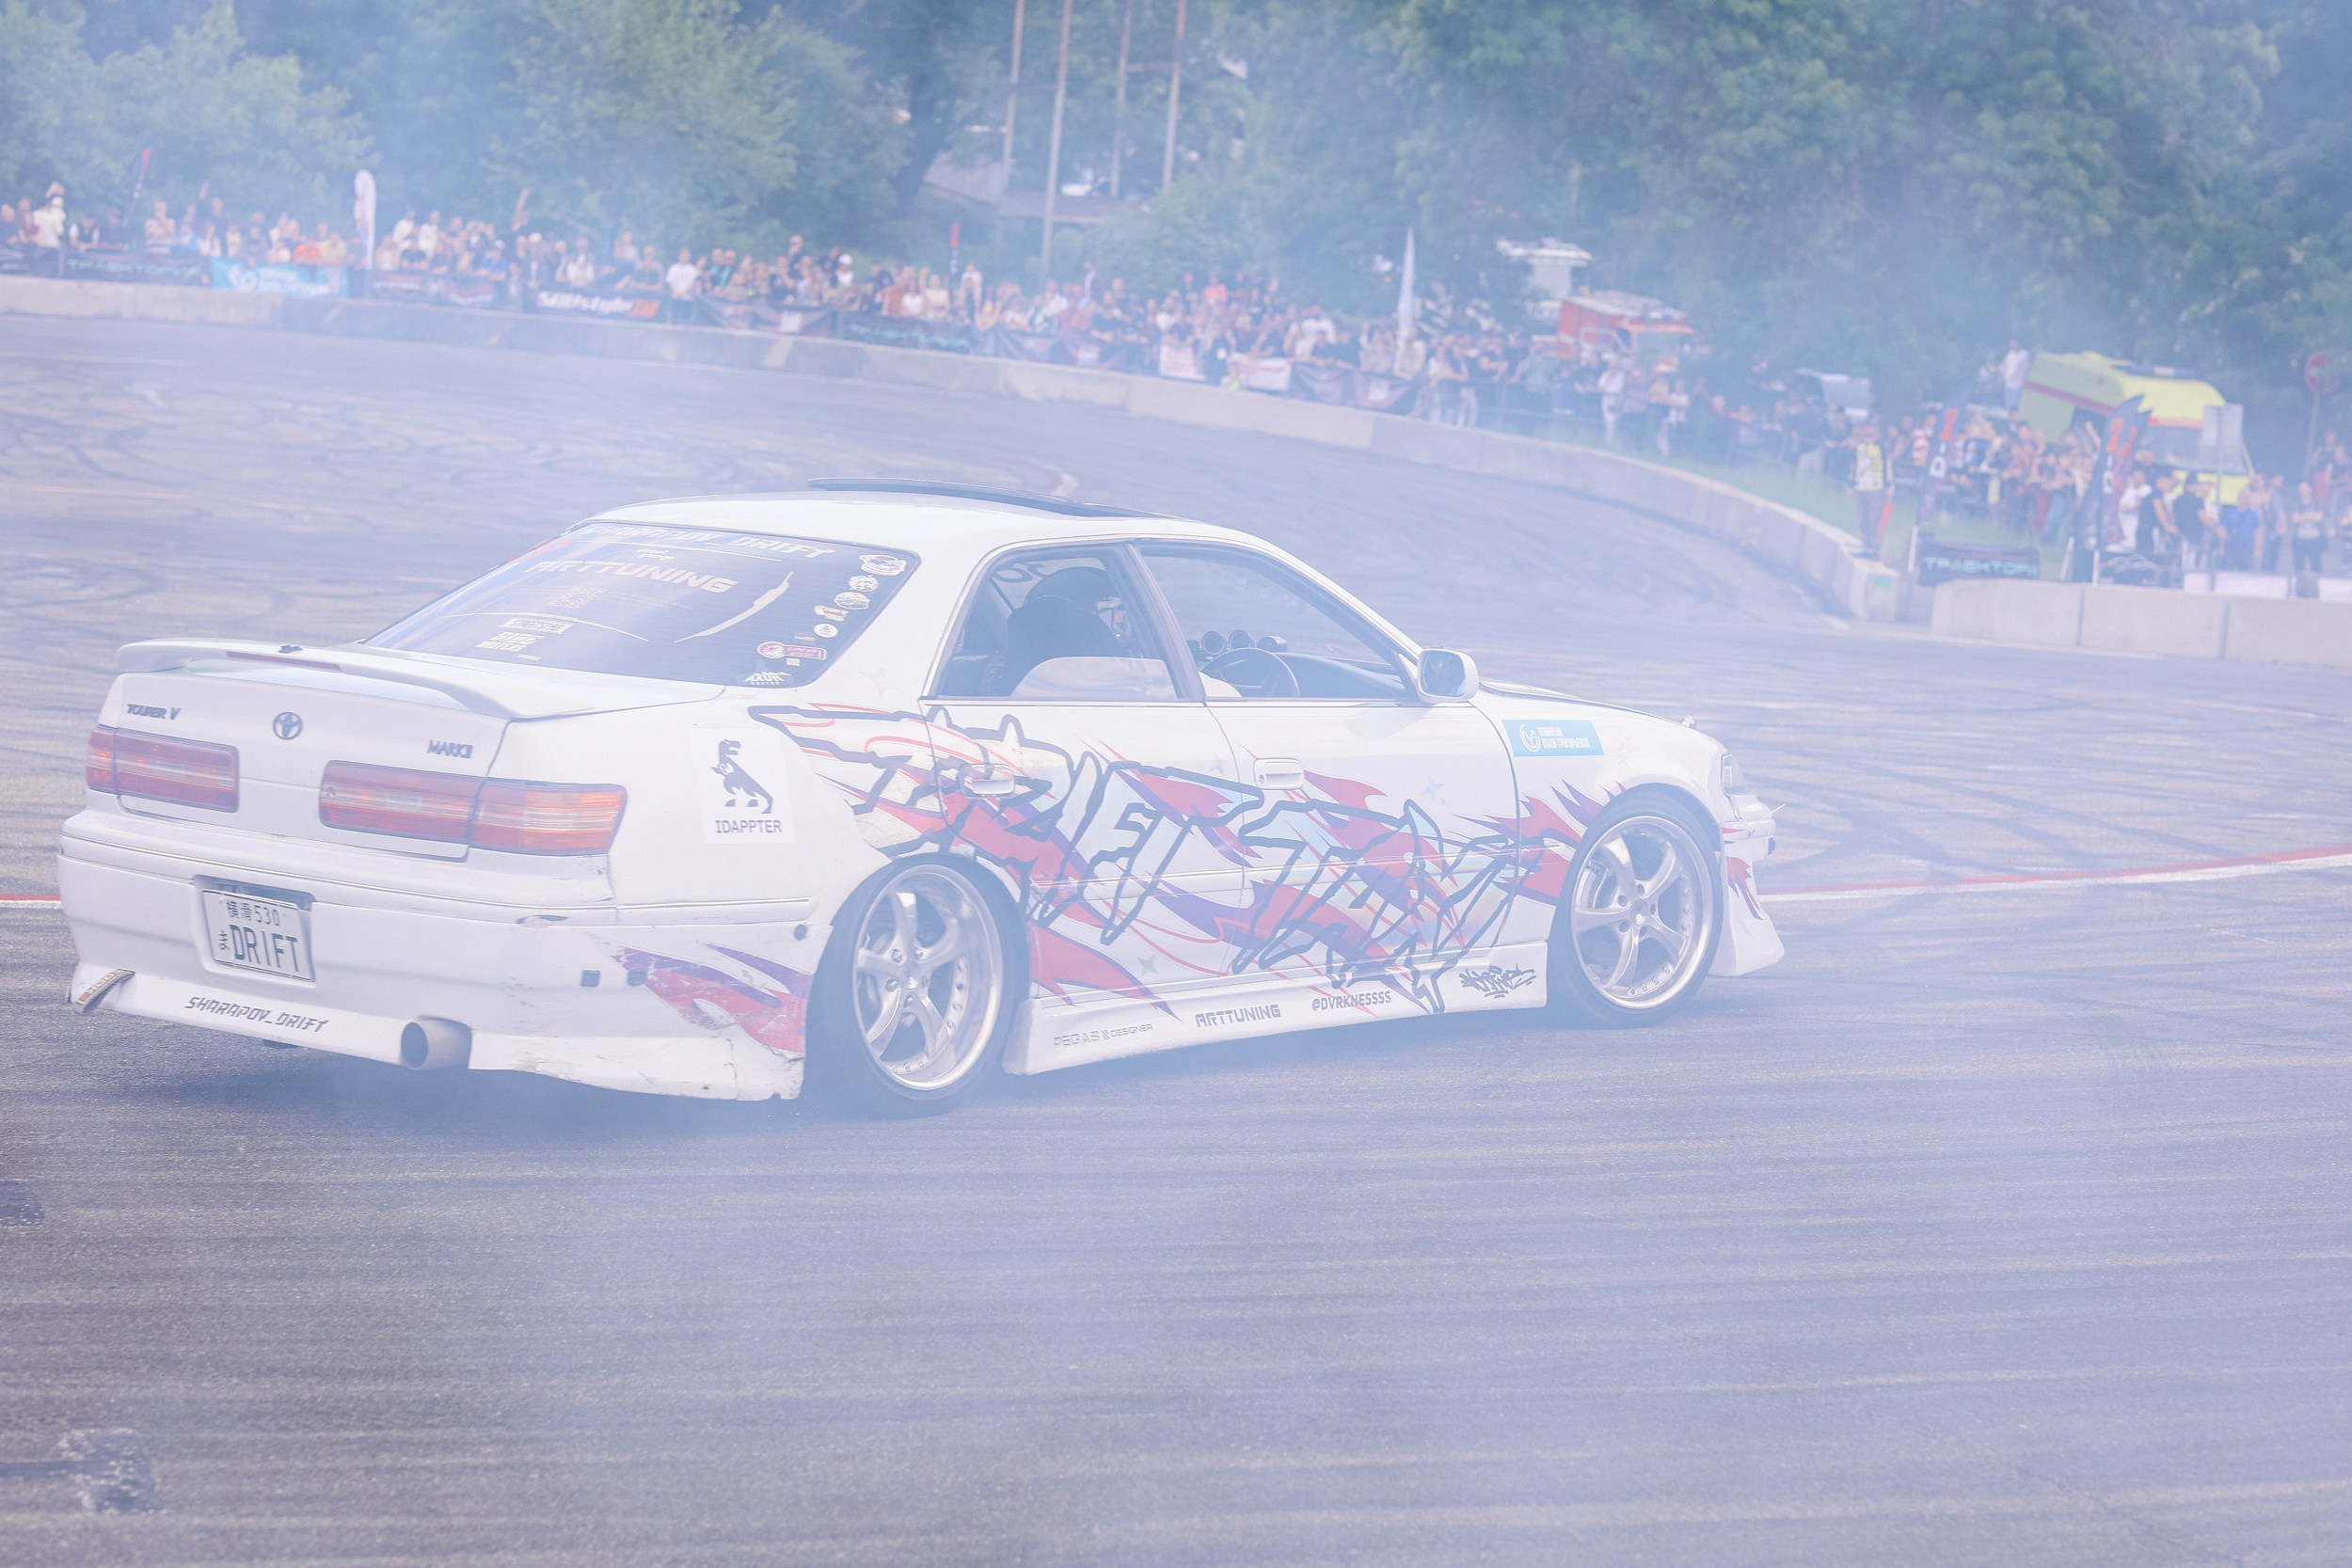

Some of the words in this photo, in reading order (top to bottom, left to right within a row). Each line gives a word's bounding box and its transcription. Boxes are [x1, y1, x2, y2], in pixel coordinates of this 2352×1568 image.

[524, 560, 739, 594] ARTTUNING
[127, 704, 167, 720] TOURER
[170, 706, 182, 720] V
[715, 819, 783, 833] IDAPPTER
[229, 924, 299, 973] DRIFT
[1311, 990, 1391, 1011] @DVRKNESSSS
[185, 996, 329, 1033] SHARAPOV_DRIFT
[1195, 1004, 1281, 1028] ARTTUNING
